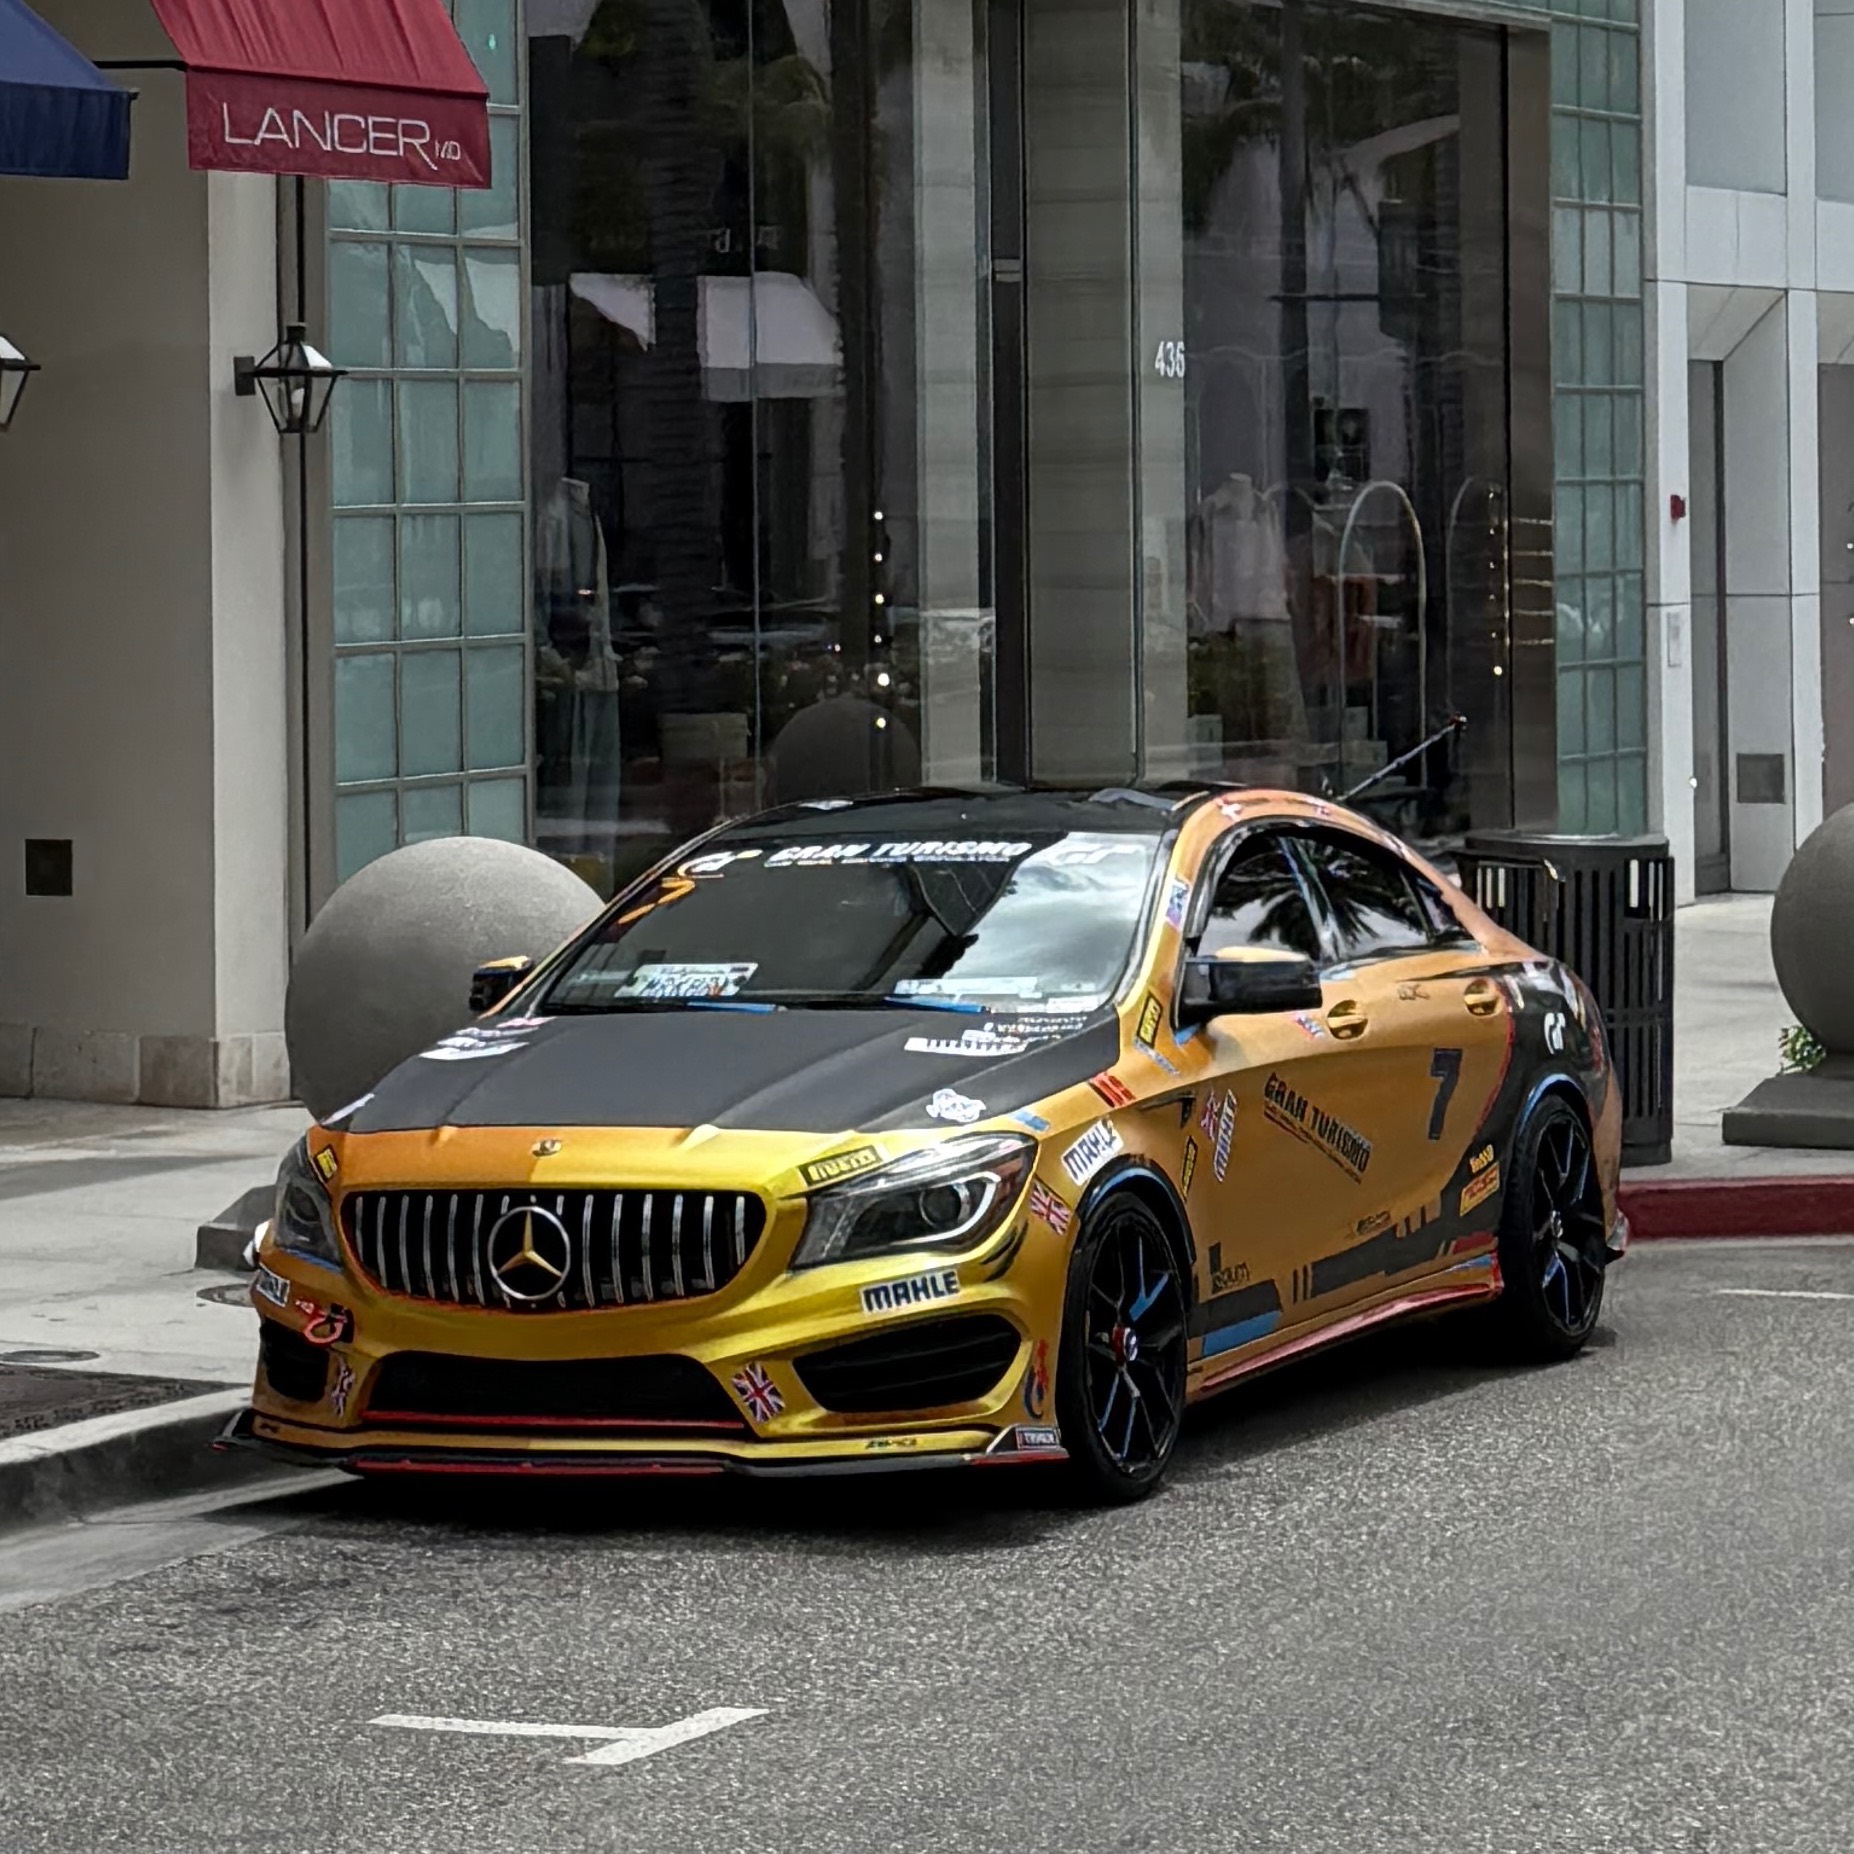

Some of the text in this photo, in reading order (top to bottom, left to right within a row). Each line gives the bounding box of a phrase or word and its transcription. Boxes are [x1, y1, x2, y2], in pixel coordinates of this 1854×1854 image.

[222, 101, 438, 170] LANCER
[1154, 340, 1185, 378] 436
[872, 841, 1033, 857] TURISMO
[1264, 1071, 1309, 1123] GRAN
[1428, 1047, 1463, 1141] 7
[863, 1270, 961, 1312] MAHLE
